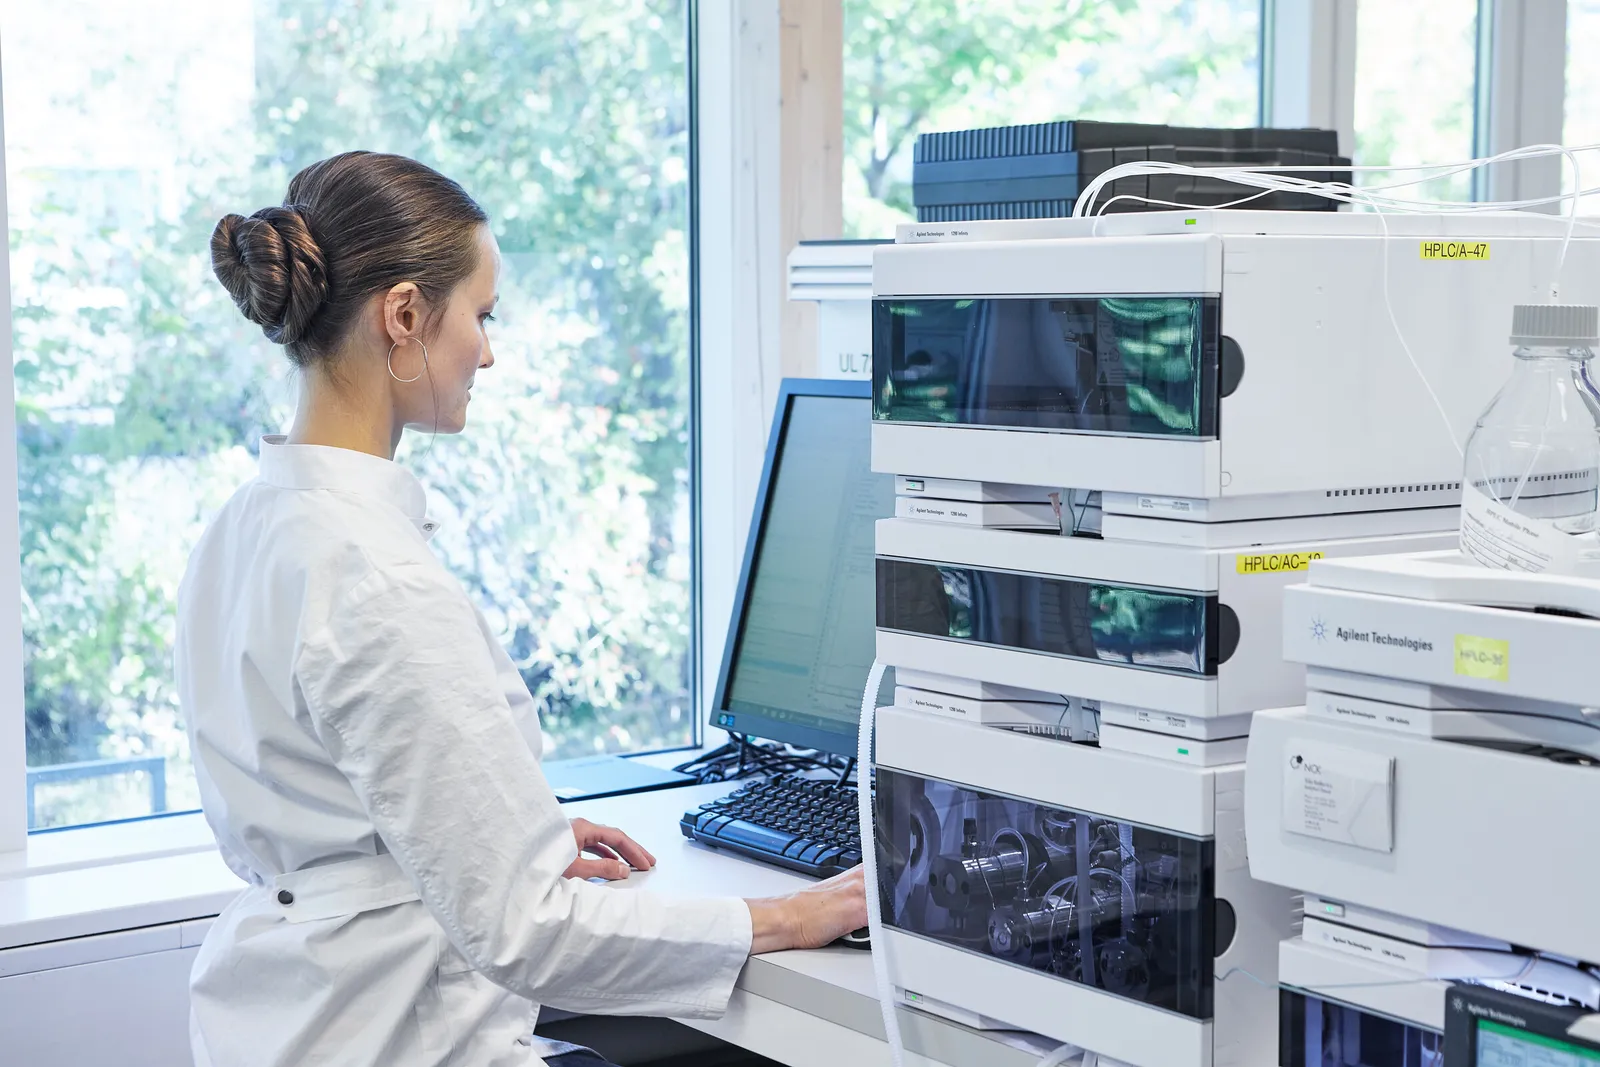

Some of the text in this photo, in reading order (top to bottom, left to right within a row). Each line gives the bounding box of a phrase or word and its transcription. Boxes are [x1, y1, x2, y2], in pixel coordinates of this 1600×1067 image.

[1424, 243, 1487, 258] HPLC/A-47
[839, 353, 872, 373] UL 7
[1336, 627, 1433, 652] Agilent Technologies
